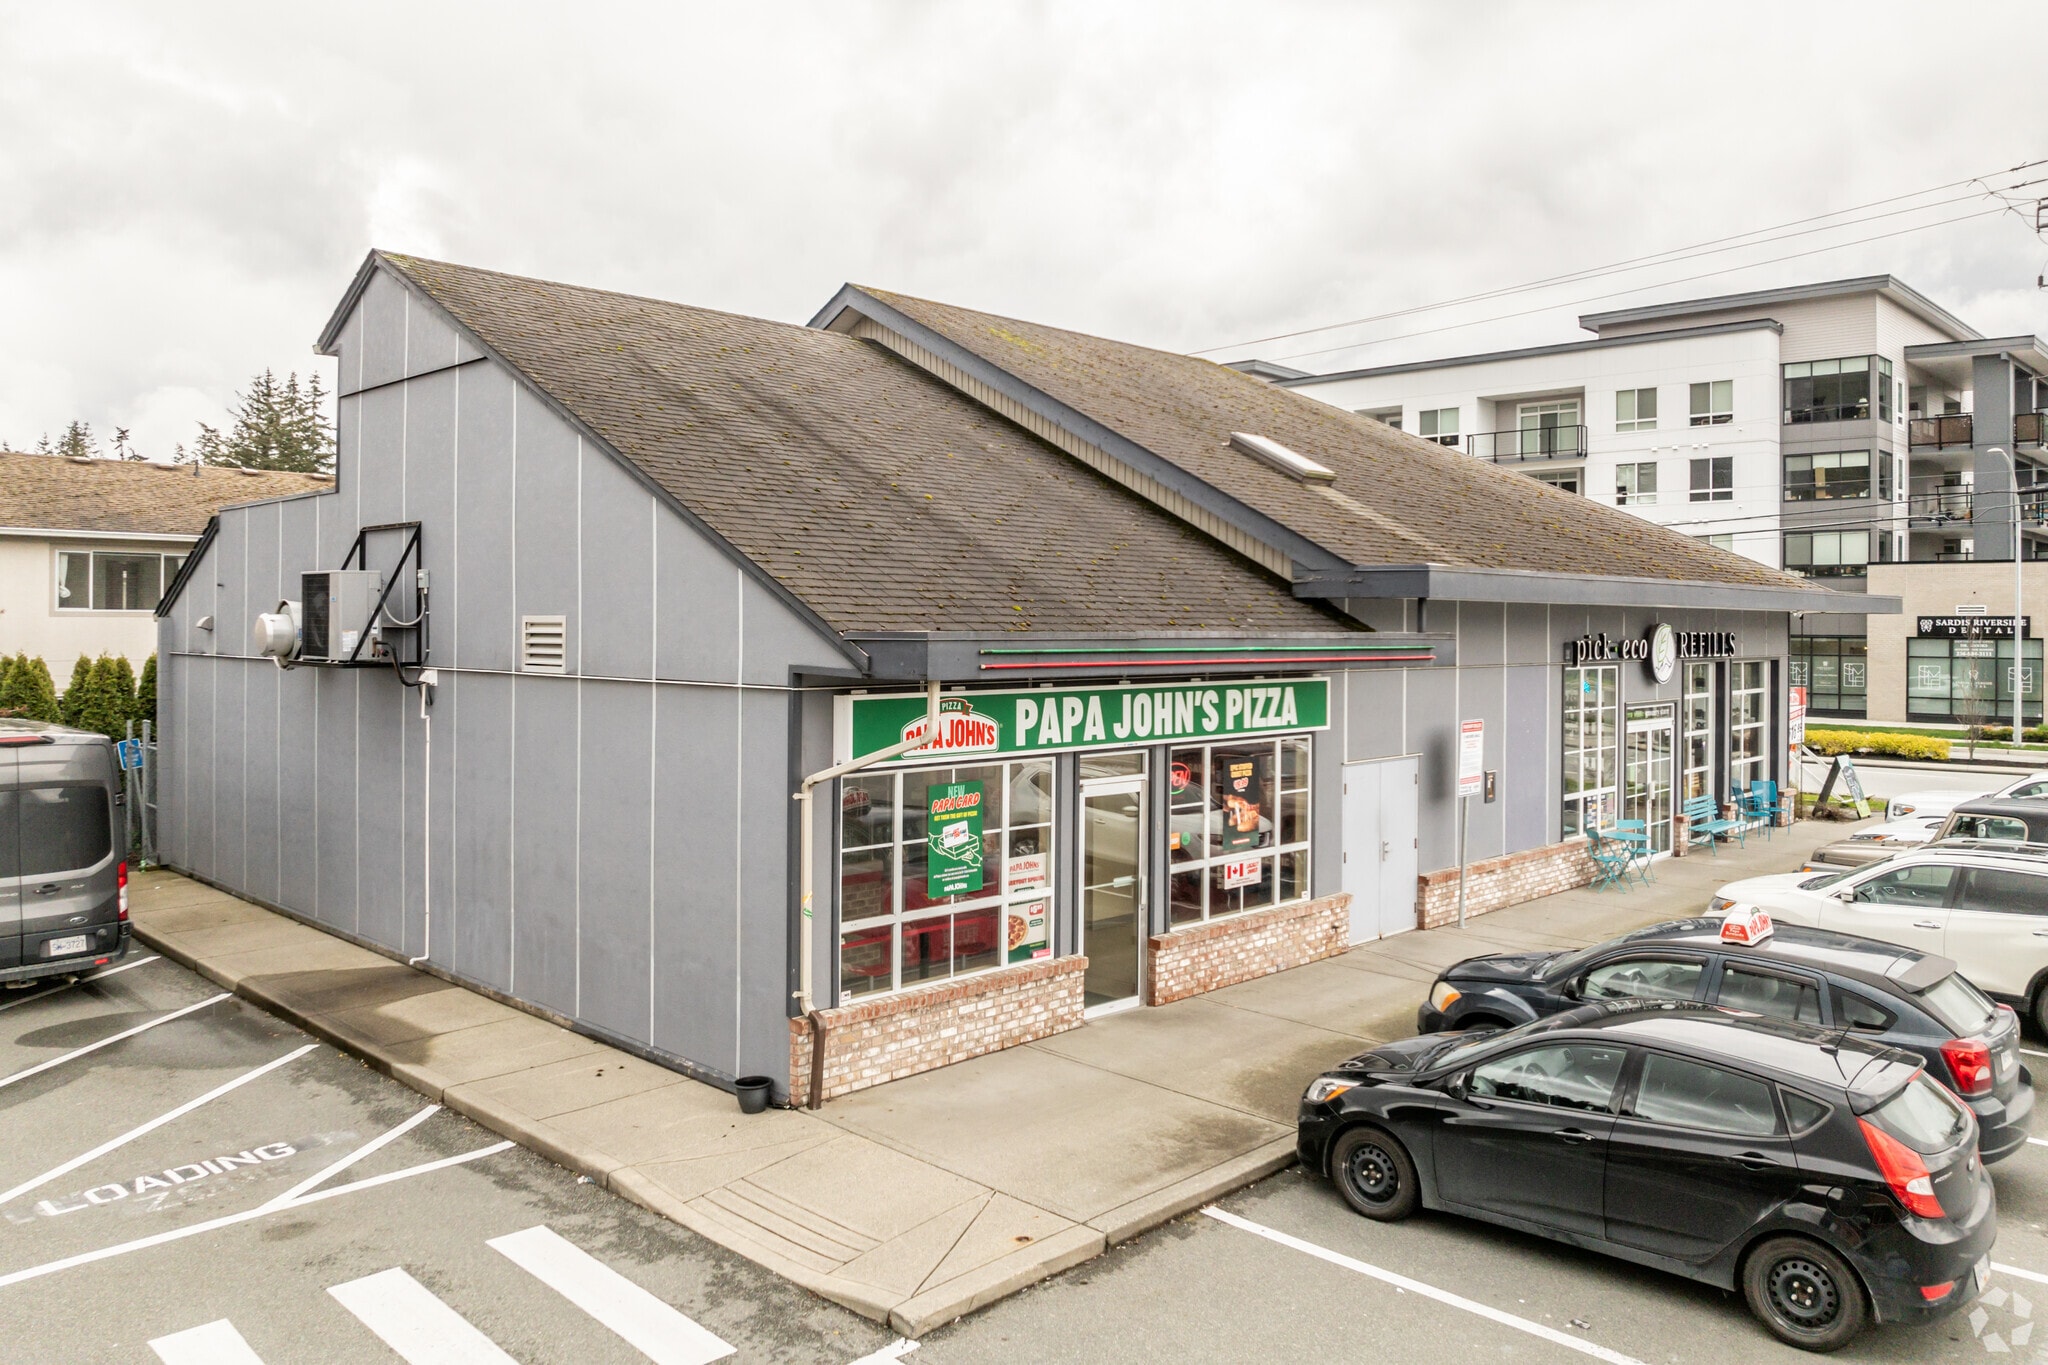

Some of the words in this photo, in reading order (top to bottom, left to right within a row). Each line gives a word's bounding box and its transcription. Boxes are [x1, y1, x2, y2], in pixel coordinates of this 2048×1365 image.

[1936, 619, 1971, 627] SARDIS
[1622, 639, 1648, 660] eco
[1680, 632, 1736, 658] REFILLS
[942, 701, 962, 711] PIZZA
[1016, 695, 1106, 747] PAPA
[1113, 689, 1220, 739] JOHN'S
[1225, 686, 1298, 730] PIZZA
[946, 719, 995, 748] JOHN'S
[948, 785, 965, 798] NEW
[931, 797, 955, 814] PAPA
[956, 792, 981, 809] CARD
[37, 1141, 297, 1216] LOADING
